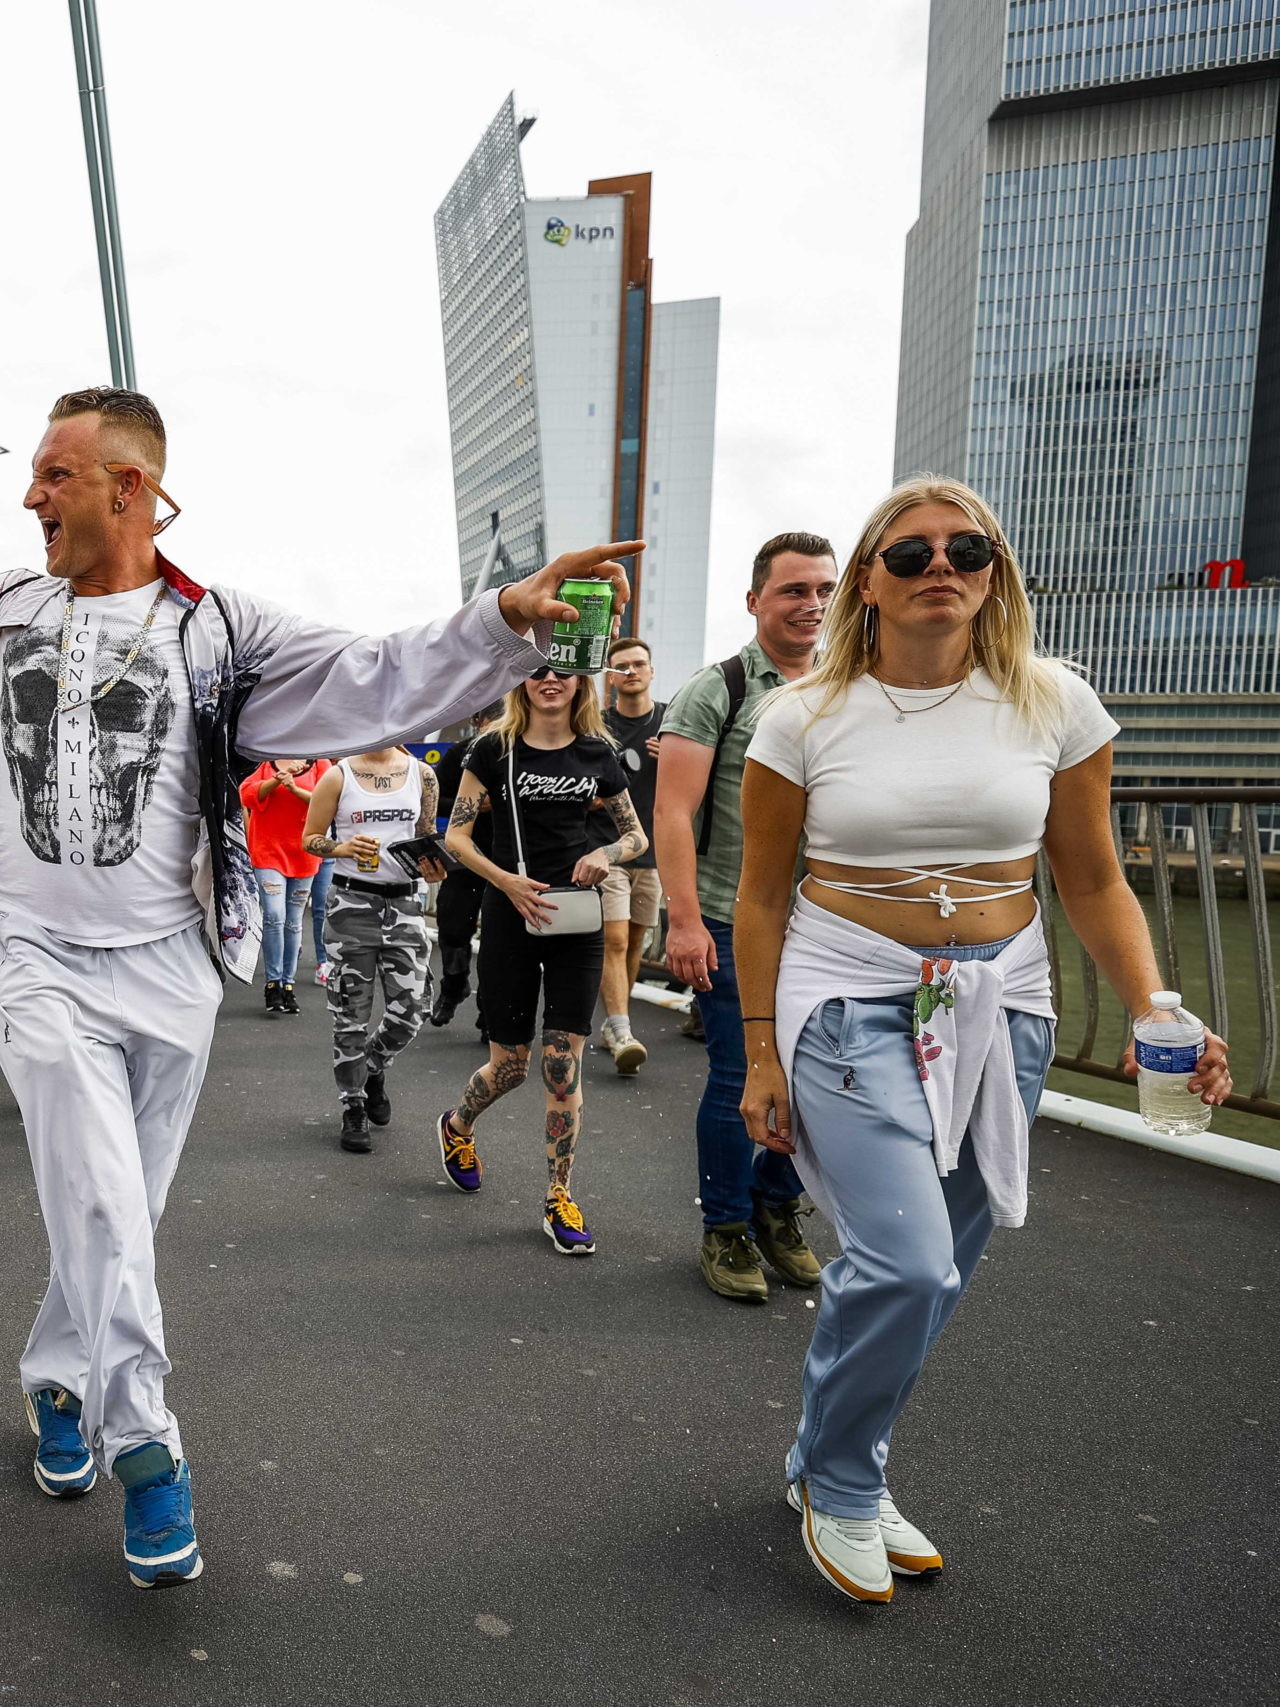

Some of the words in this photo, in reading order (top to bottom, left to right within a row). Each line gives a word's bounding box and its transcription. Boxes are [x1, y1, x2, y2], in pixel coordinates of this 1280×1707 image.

[574, 223, 615, 244] kpn
[67, 613, 90, 704] ICONO
[551, 643, 577, 662] en
[65, 739, 86, 866] MILANO
